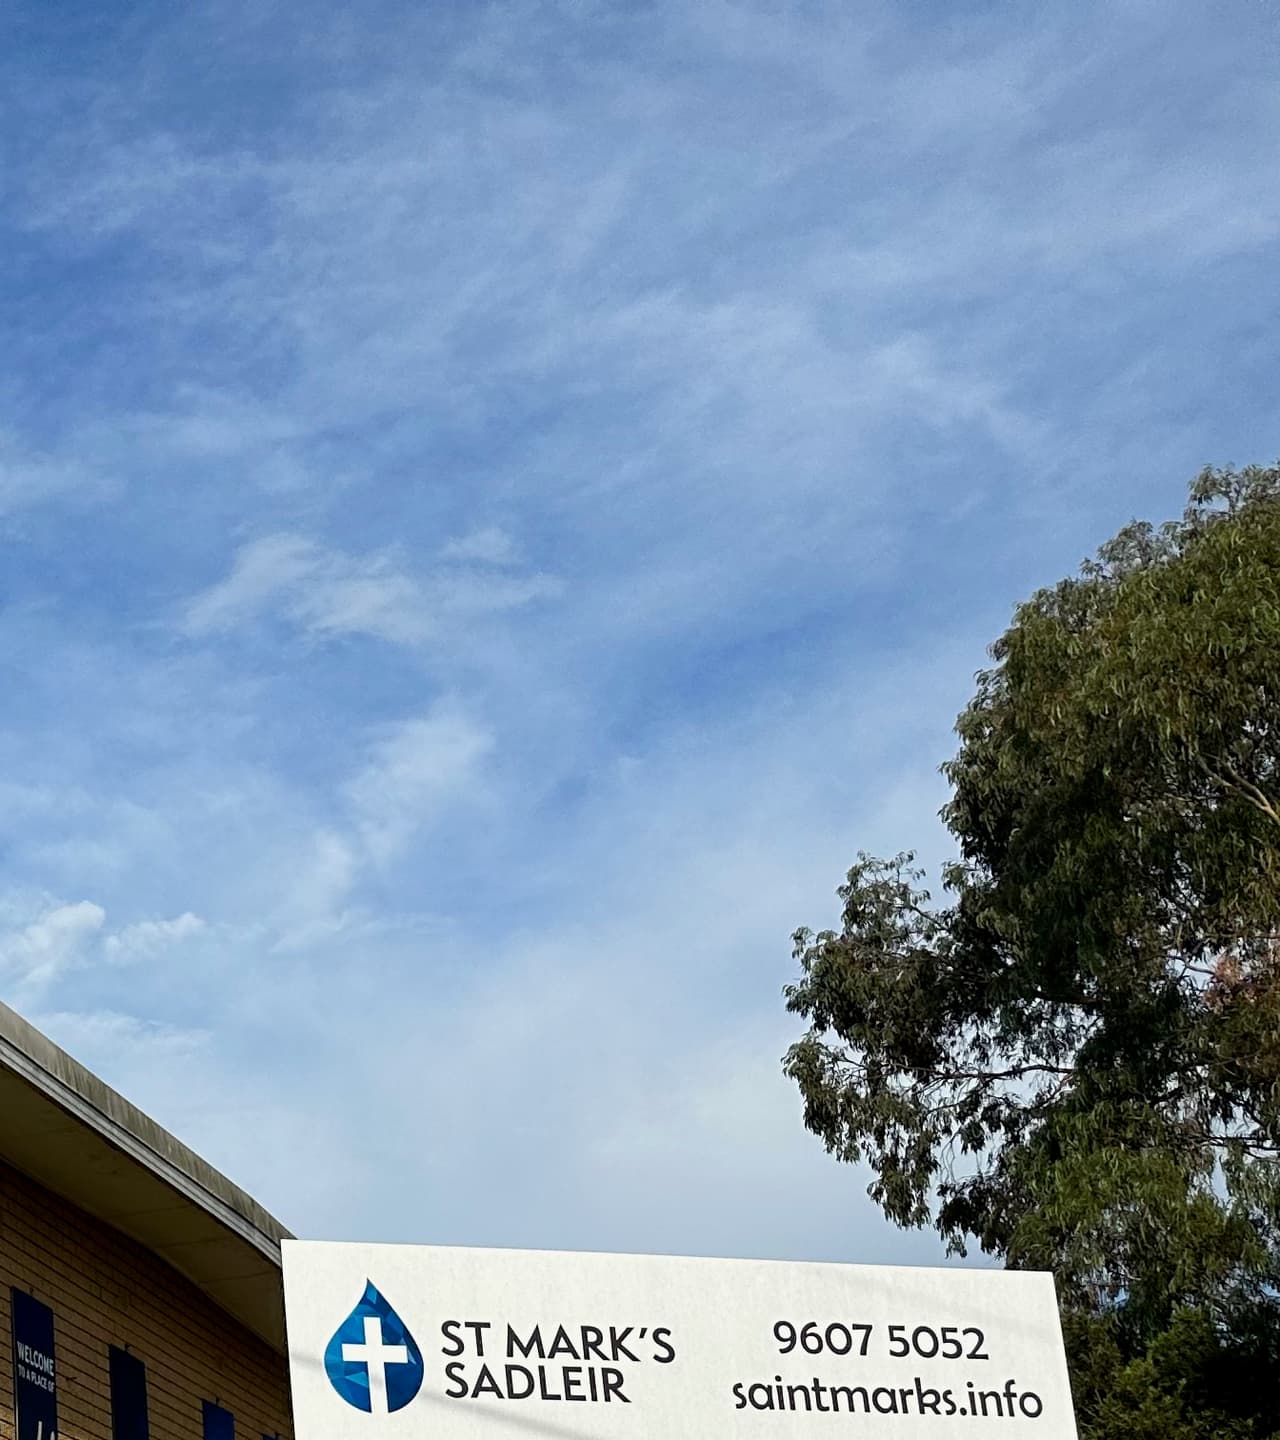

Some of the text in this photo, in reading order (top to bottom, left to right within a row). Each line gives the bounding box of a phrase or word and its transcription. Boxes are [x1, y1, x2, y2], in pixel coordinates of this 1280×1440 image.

[17, 1341, 54, 1377] WELCOME
[441, 1320, 676, 1364] ST MARK'S
[773, 1320, 989, 1361] 9607 5052
[31, 1371, 47, 1390] PLACE
[444, 1363, 632, 1403] SADLEIR
[732, 1375, 1043, 1418] saintmarks.info
